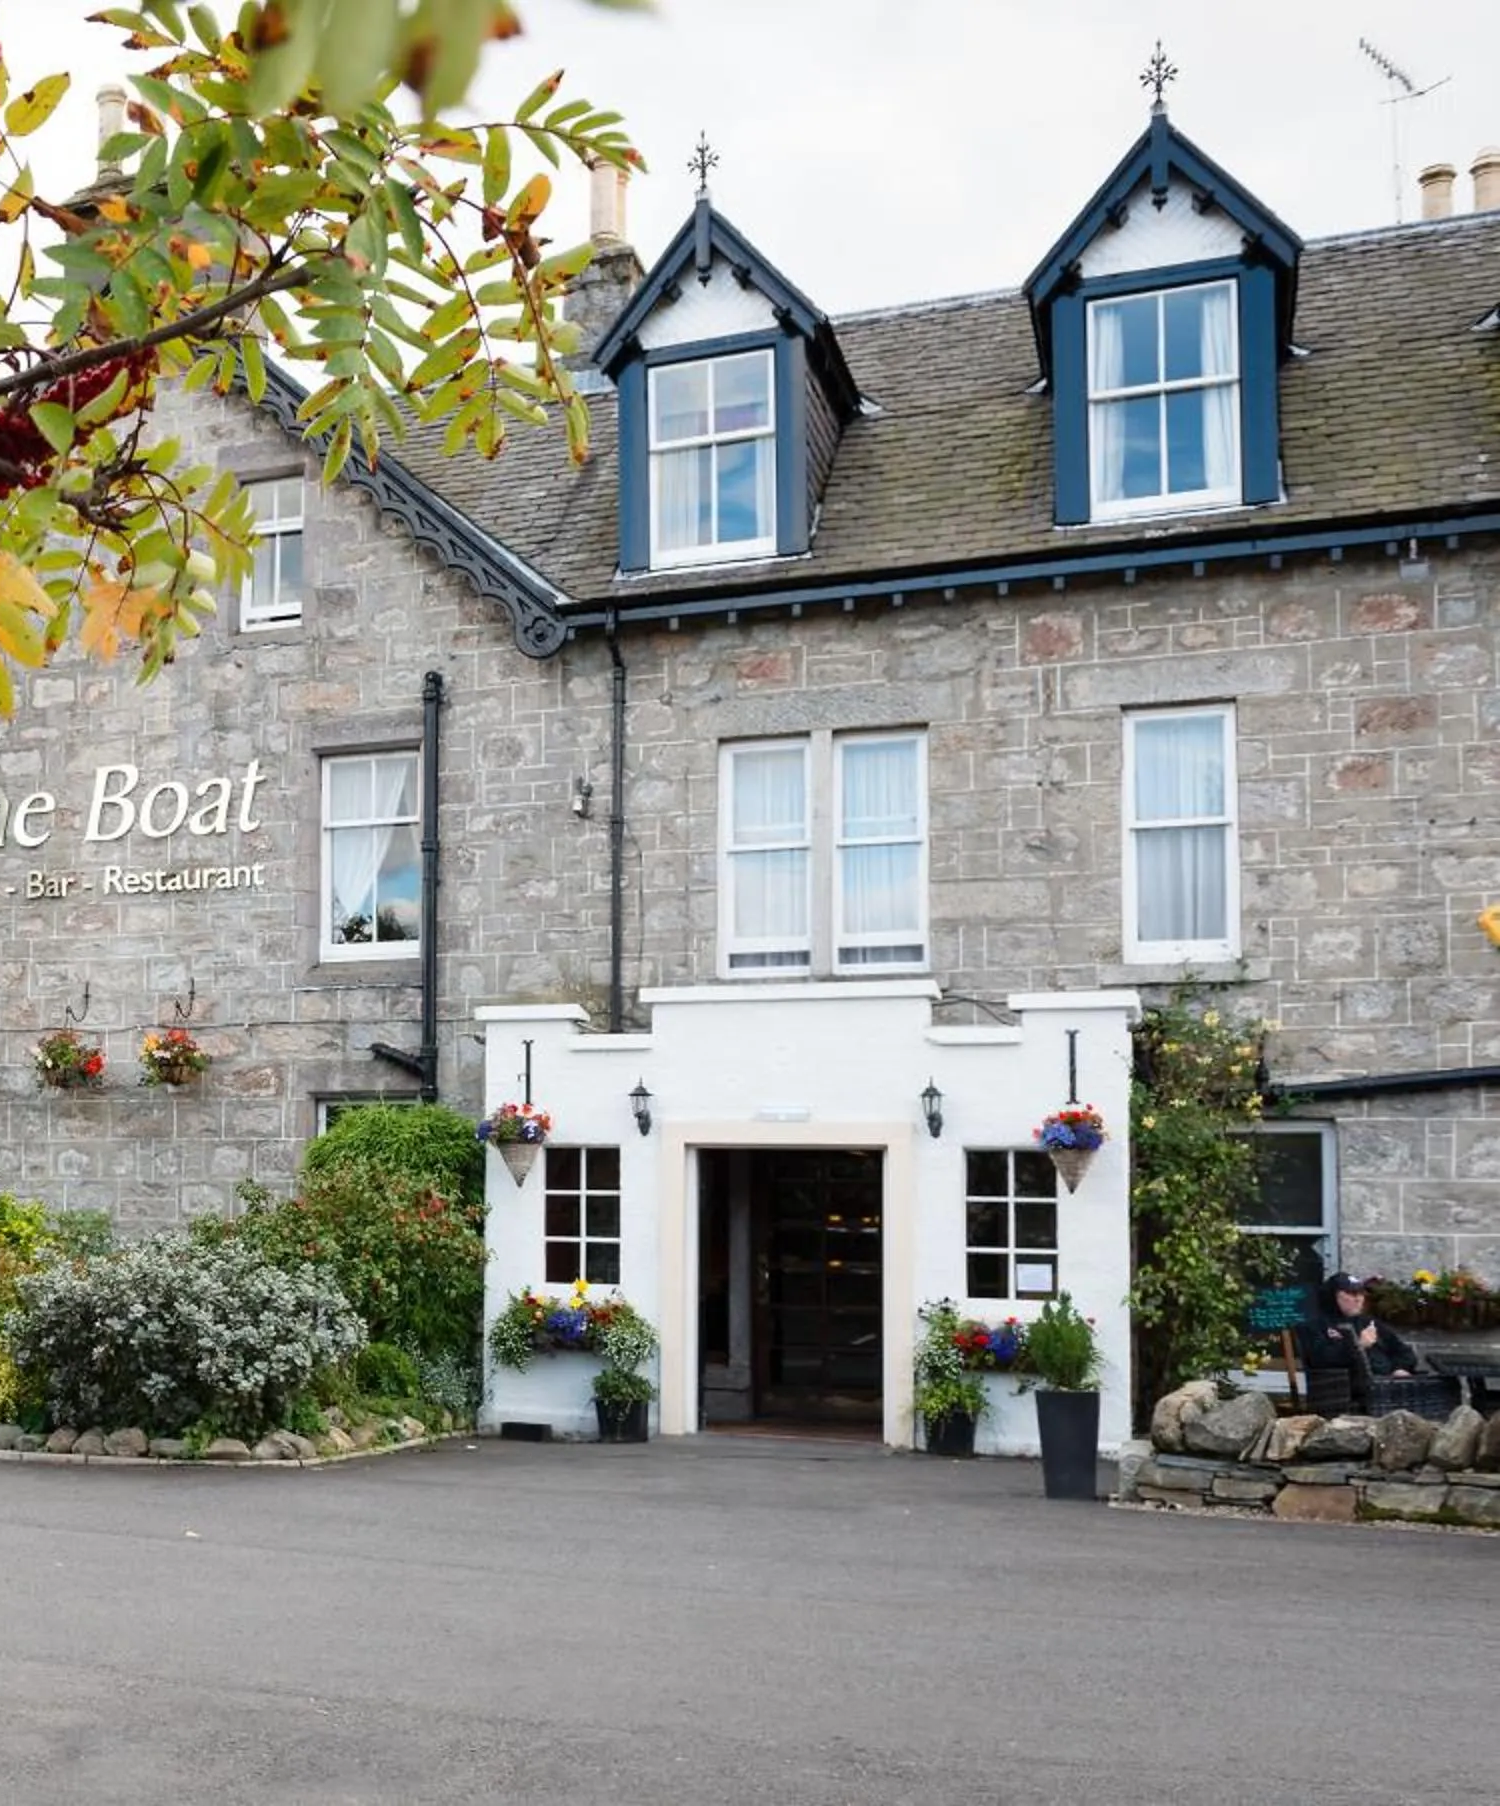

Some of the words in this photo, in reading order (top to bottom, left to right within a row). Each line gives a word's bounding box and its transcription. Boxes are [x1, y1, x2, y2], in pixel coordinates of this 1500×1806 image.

[84, 758, 267, 843] Boat
[25, 871, 75, 899] Bar
[103, 862, 266, 895] Restaurant
